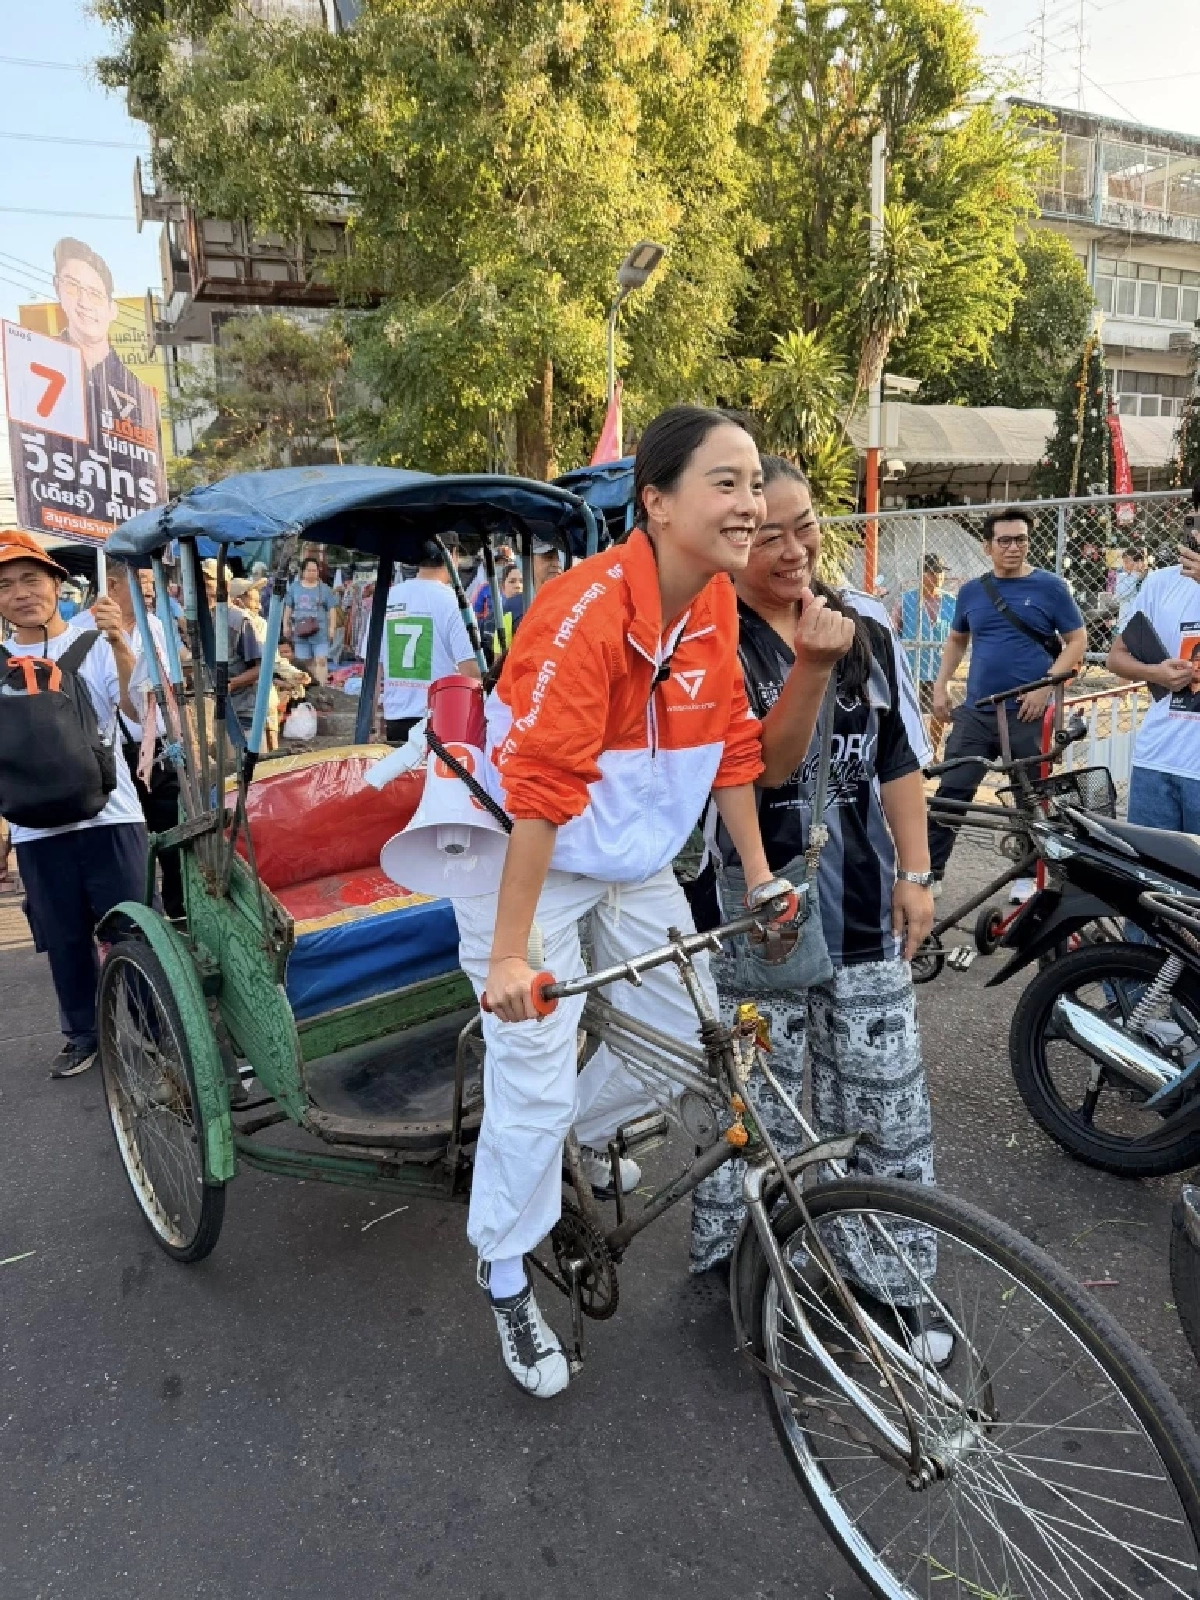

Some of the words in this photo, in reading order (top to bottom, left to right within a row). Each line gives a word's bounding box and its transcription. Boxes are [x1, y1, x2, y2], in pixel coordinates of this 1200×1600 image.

[30, 362, 67, 418] 7
[22, 432, 157, 504] วีรภัทร
[394, 622, 423, 669] 7
